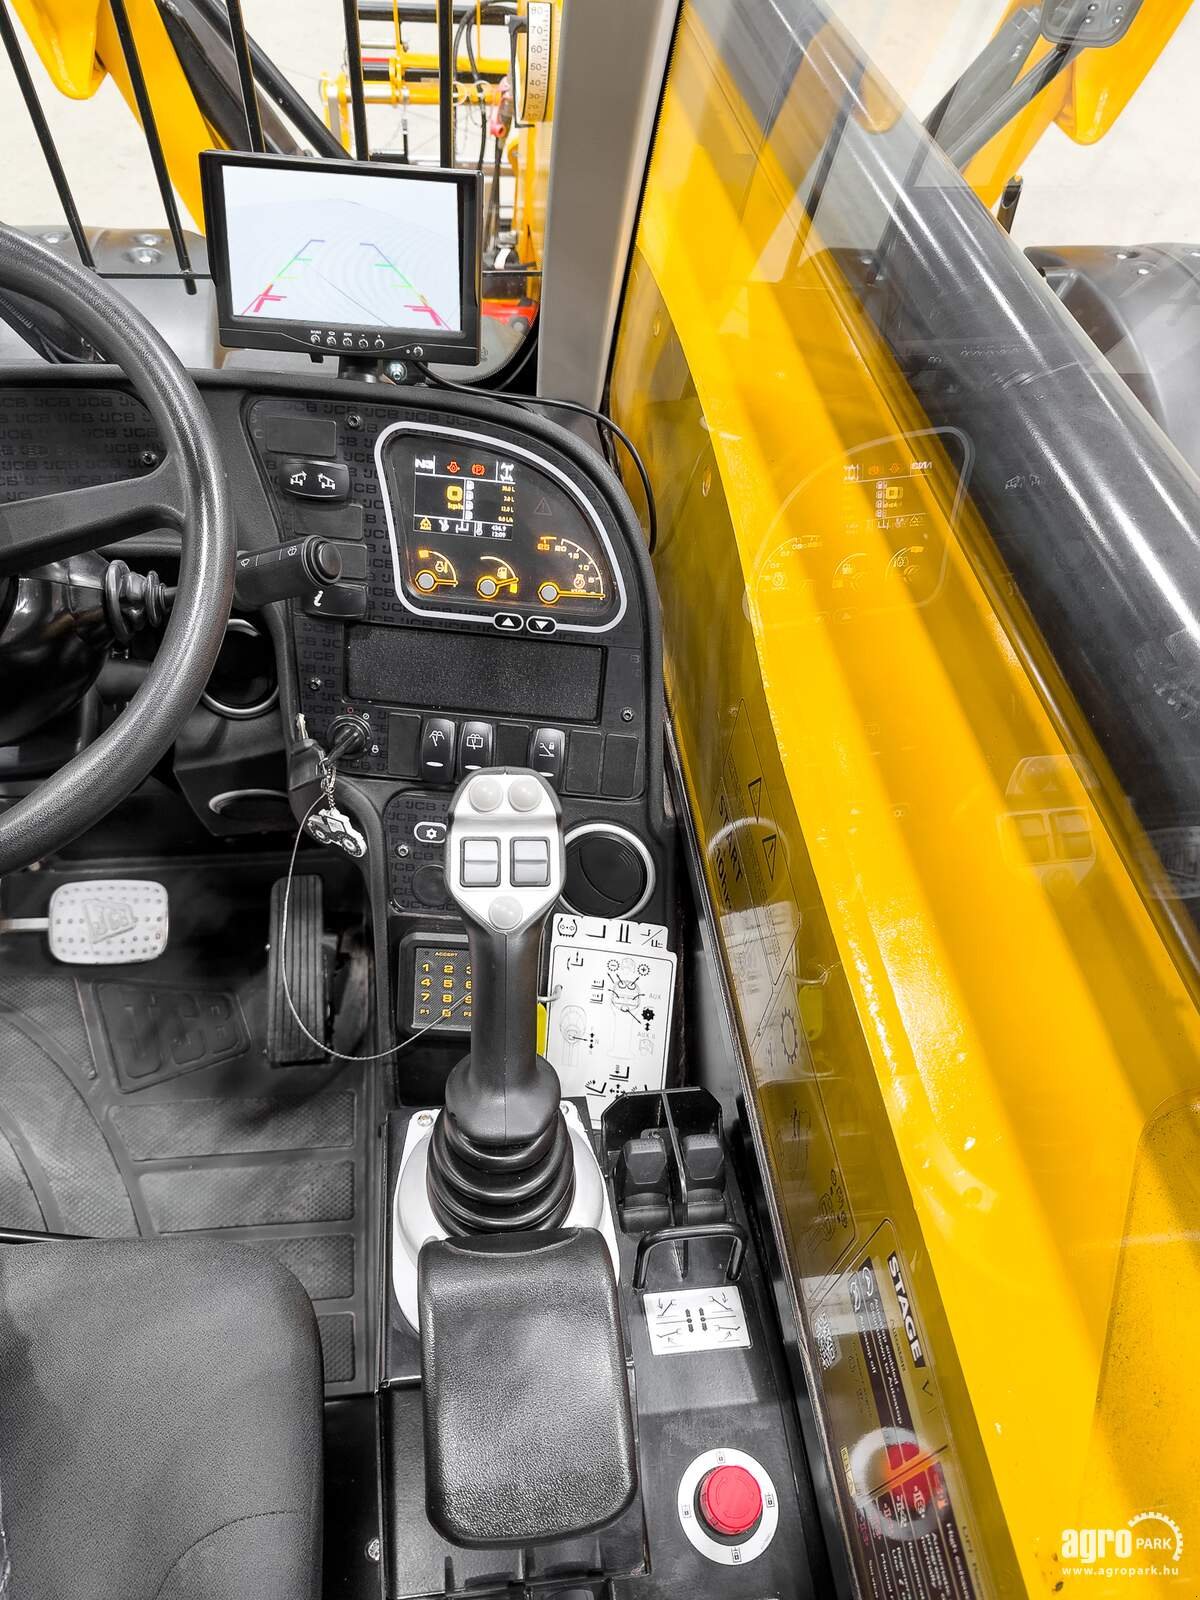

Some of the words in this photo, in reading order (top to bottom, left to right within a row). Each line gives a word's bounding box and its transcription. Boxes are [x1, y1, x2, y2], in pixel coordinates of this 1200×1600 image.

[531, 45, 542, 54] 60
[530, 63, 542, 71] 50
[446, 485, 463, 502] 0
[447, 503, 464, 511] kph
[422, 964, 430, 972] 1
[444, 965, 454, 973] 2
[421, 979, 431, 987] 4
[444, 980, 452, 988] 5
[421, 992, 430, 1000] 7
[442, 994, 452, 1002] 8
[888, 1256, 922, 1362] STAGE
